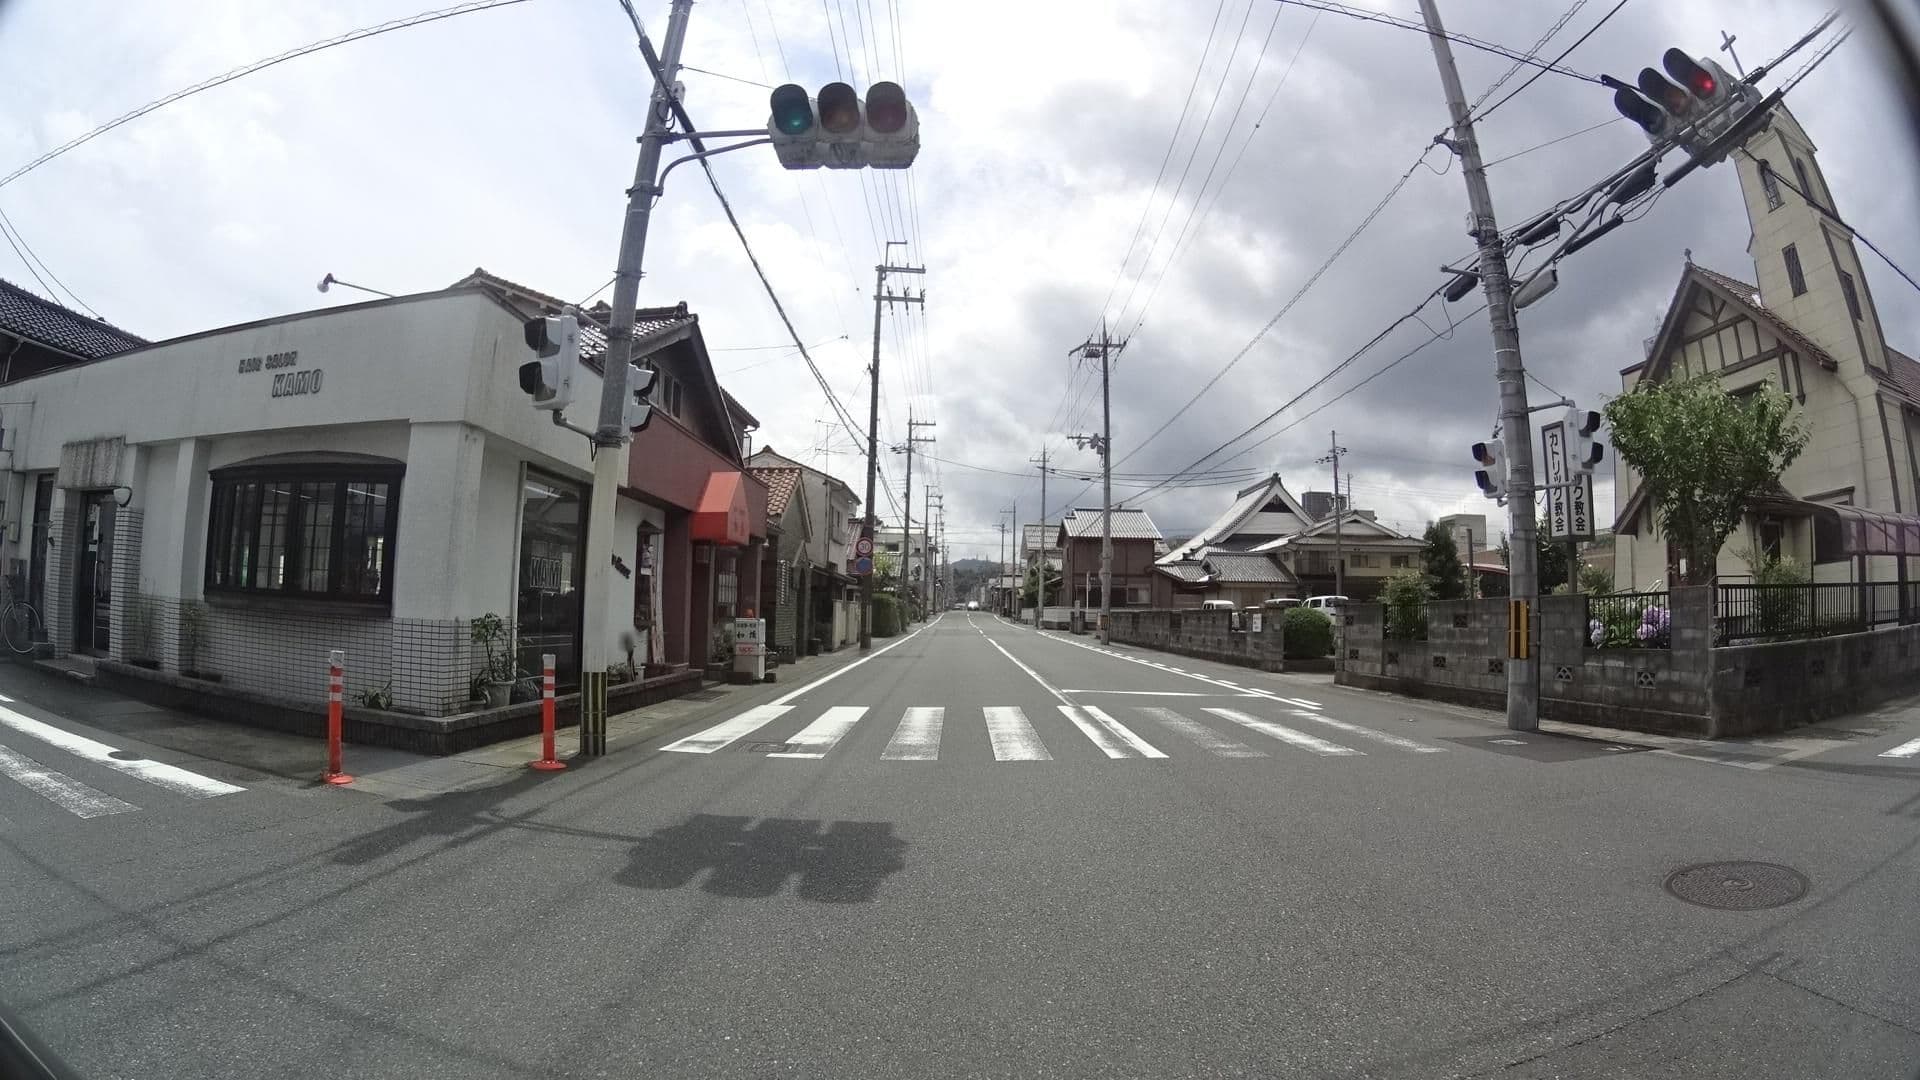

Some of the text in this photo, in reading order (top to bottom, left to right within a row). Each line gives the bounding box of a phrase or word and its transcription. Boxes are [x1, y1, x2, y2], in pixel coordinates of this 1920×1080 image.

[265, 351, 297, 370] SALON
[272, 369, 323, 398] KAMO
[1549, 432, 1565, 533] カトリック教会
[860, 543, 870, 551] 30
[529, 557, 570, 590] KAM
